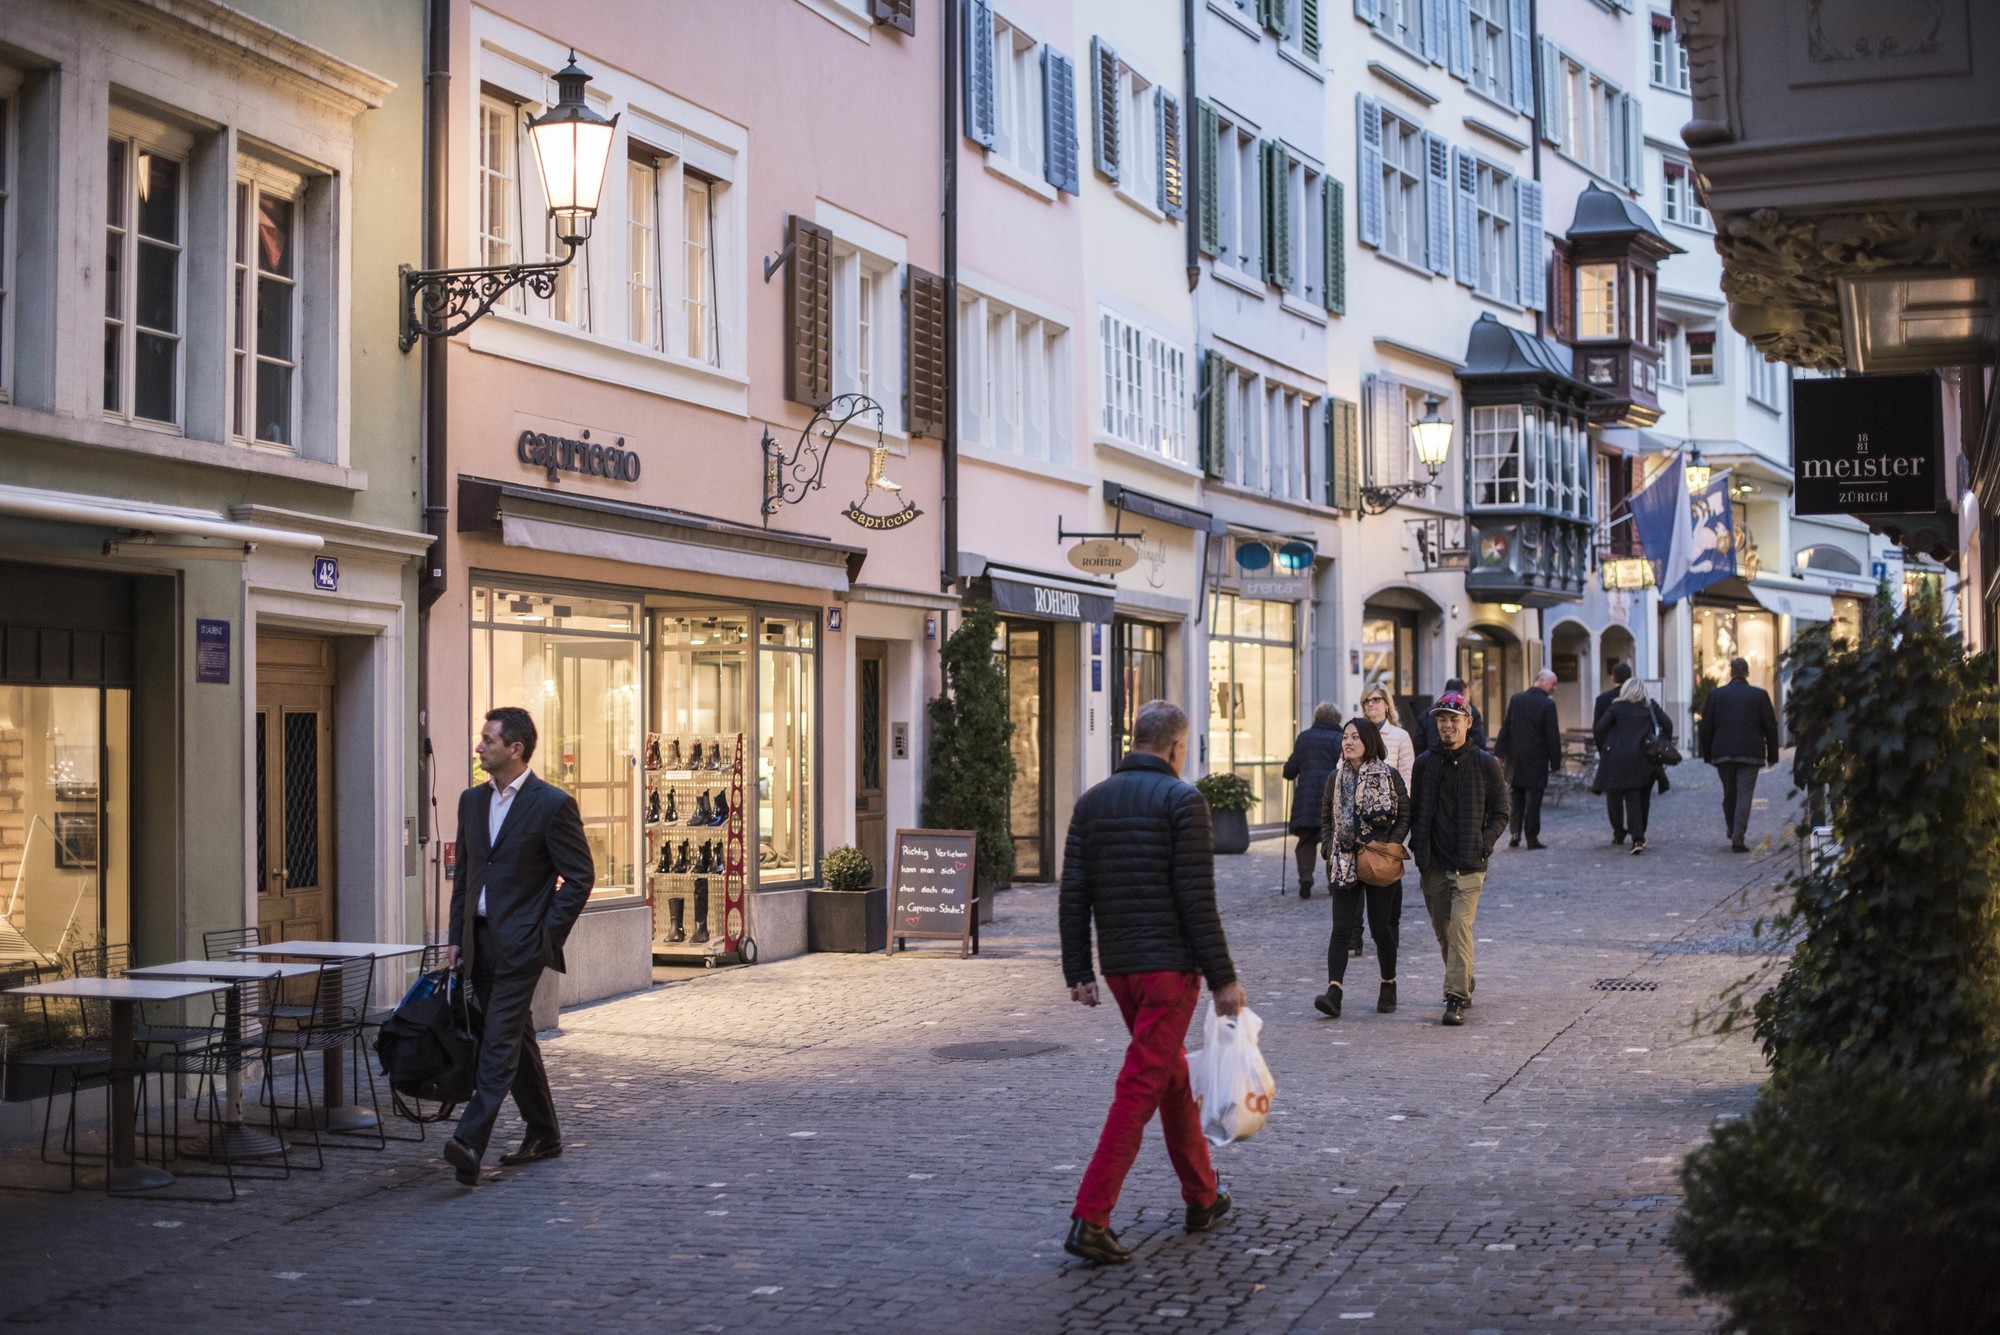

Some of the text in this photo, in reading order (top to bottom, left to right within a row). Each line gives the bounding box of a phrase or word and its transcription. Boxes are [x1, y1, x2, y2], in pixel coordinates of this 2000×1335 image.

[1858, 433, 1869, 442] 18
[1857, 442, 1868, 451] 81
[518, 429, 641, 483] capriccio
[1802, 453, 1925, 478] meister
[1839, 491, 1888, 503] ZÜRICH
[850, 509, 914, 529] capriccio
[1082, 557, 1122, 567] ROHMIR
[319, 562, 334, 585] 42
[1034, 586, 1081, 618] ROHMIR
[901, 845, 929, 860] Richtig
[901, 864, 917, 873] kann
[940, 867, 956, 875] sich
[920, 885, 938, 894] doch
[941, 887, 955, 895] nur
[897, 904, 905, 912] in
